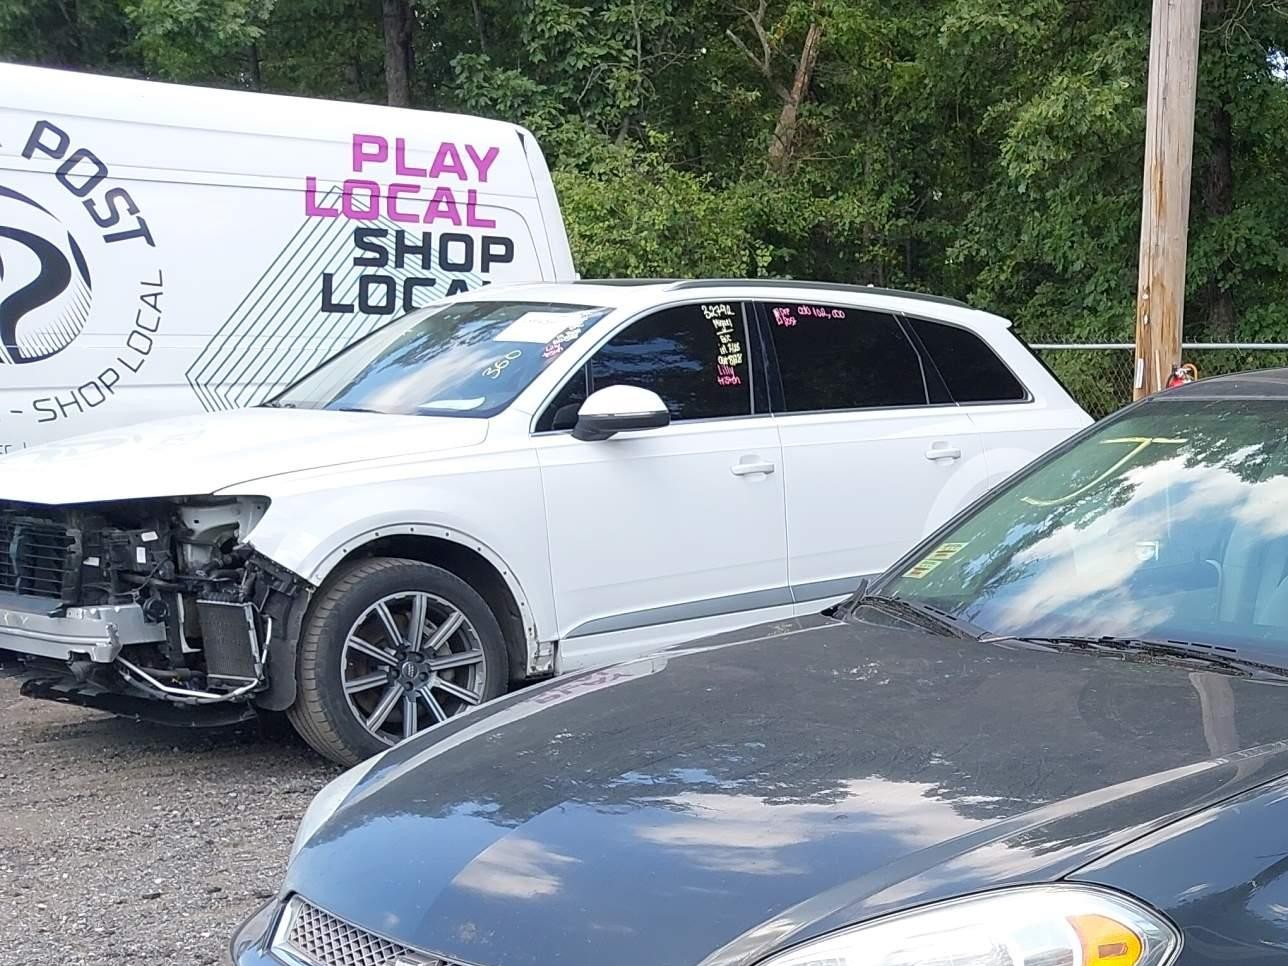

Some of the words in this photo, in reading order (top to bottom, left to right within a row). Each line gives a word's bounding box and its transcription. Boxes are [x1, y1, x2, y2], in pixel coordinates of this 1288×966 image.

[21, 119, 156, 248] POST
[352, 133, 500, 183] PLAY
[305, 175, 496, 229] LOCAL
[353, 227, 515, 273] SHOP
[32, 367, 120, 423] SHOP
[117, 268, 164, 374] LOCAL
